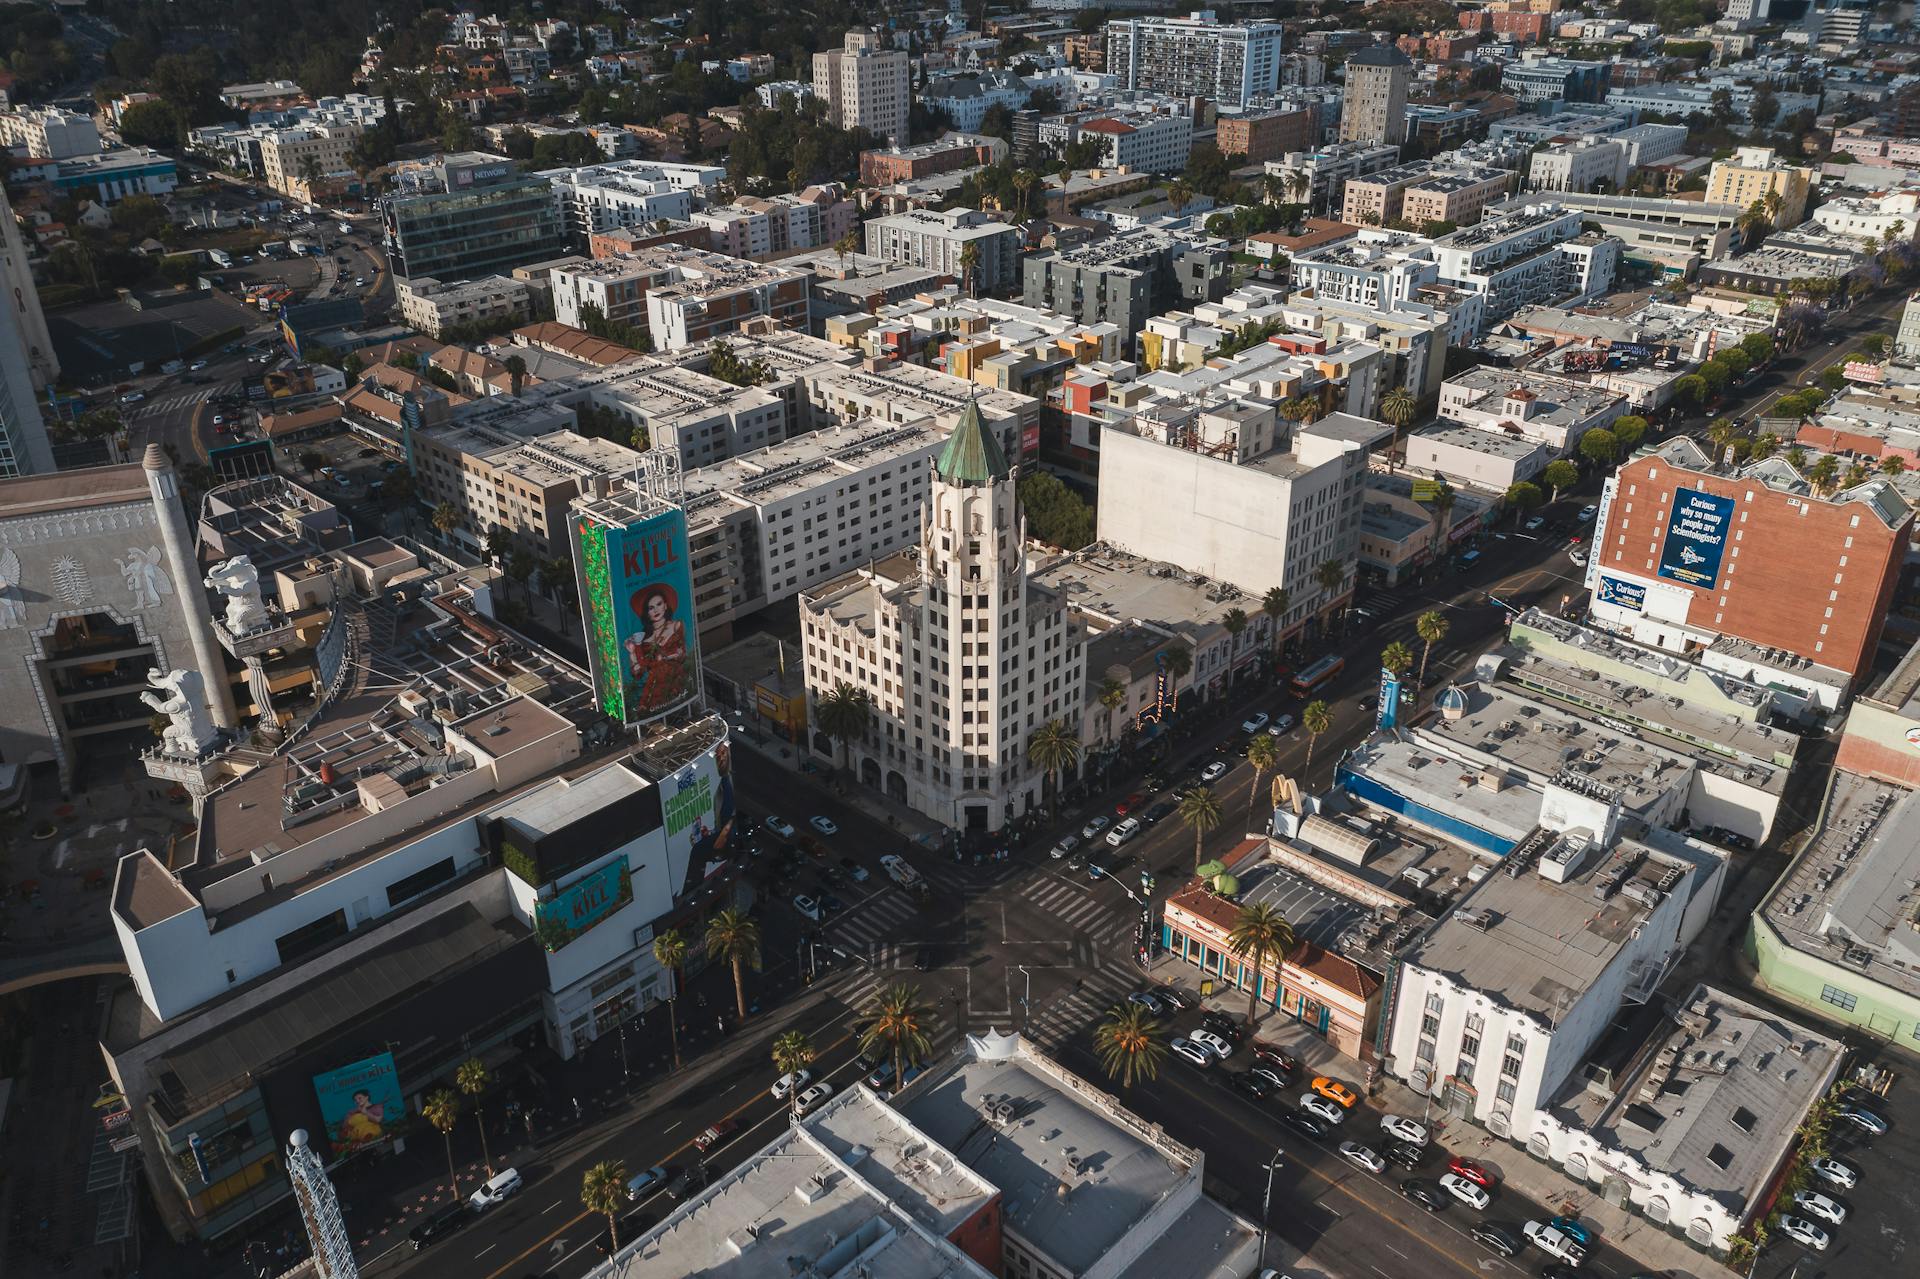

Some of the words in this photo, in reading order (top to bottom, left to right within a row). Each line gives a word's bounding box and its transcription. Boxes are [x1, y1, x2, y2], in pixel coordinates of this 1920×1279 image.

[475, 168, 507, 179] NETWORK
[1691, 496, 1717, 511] Curious
[1680, 506, 1694, 518] why
[1694, 511, 1702, 519] so
[1703, 512, 1722, 525] many
[1681, 518, 1703, 529] people
[1703, 524, 1715, 533] are
[1672, 524, 1721, 545] Scientologists?
[622, 538, 680, 578] KILL
[1616, 582, 1644, 598] Curious?
[664, 784, 699, 816] CONQUER
[666, 790, 712, 838] MORNING
[573, 881, 609, 921] KILL
